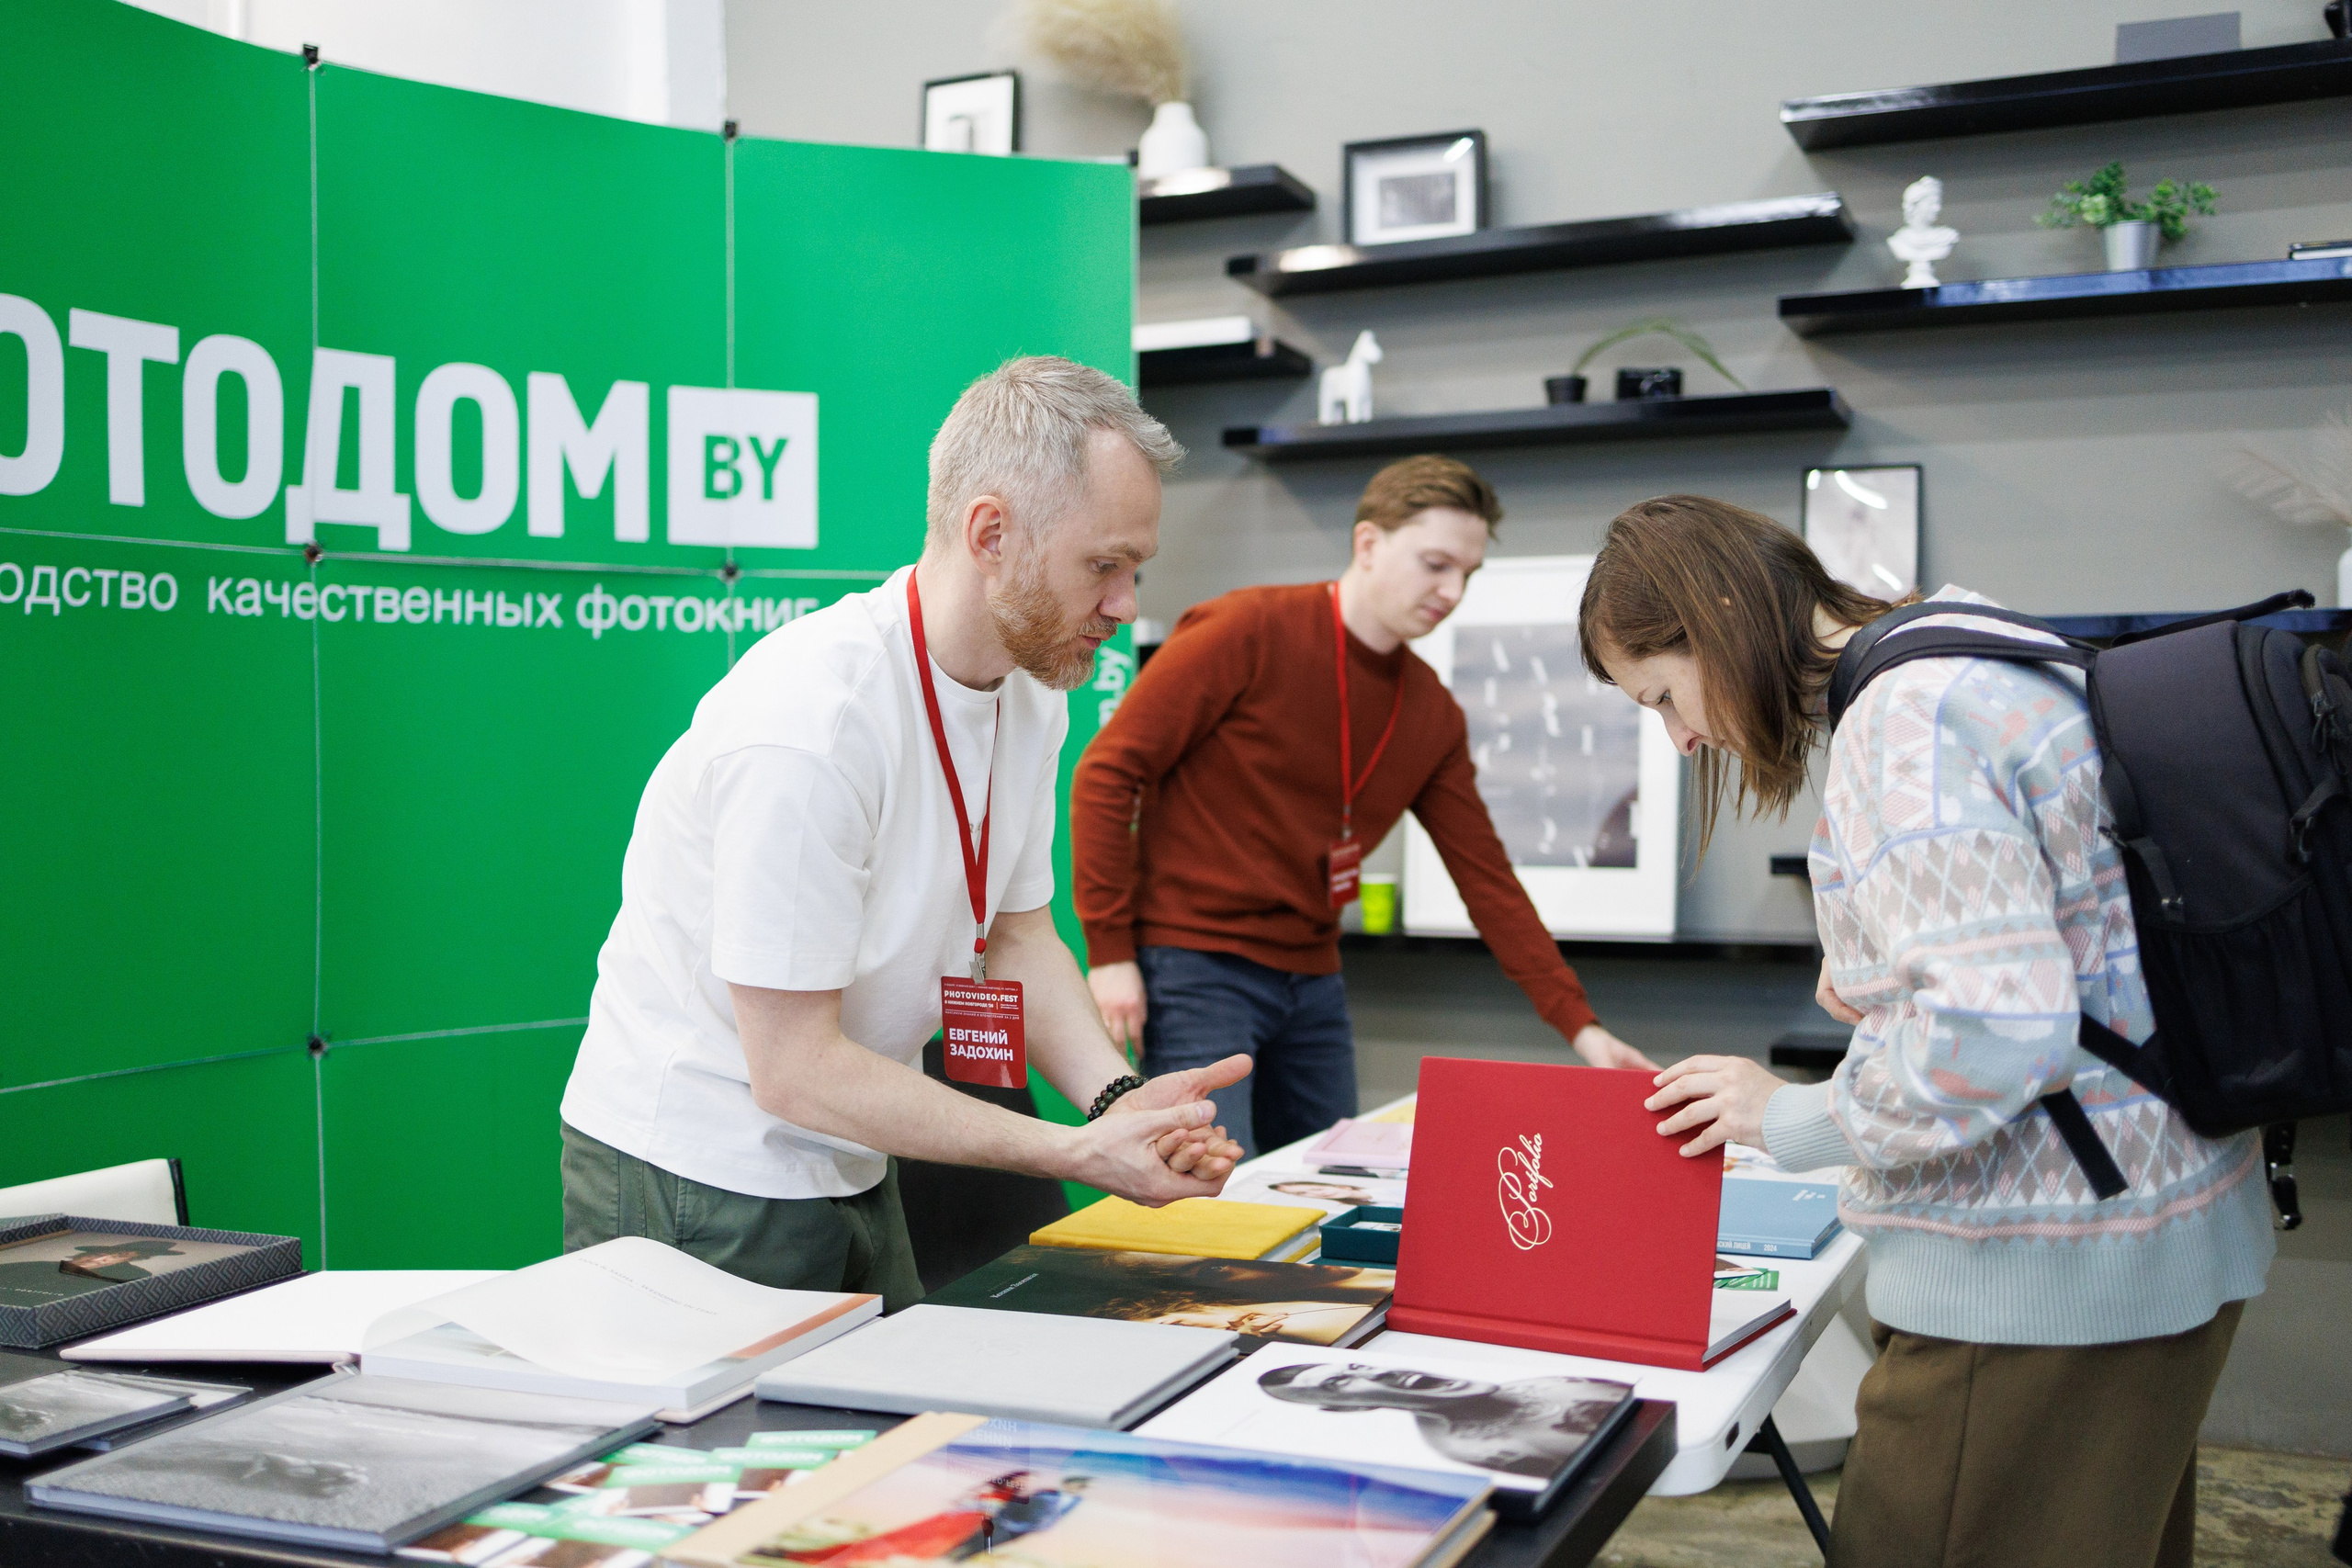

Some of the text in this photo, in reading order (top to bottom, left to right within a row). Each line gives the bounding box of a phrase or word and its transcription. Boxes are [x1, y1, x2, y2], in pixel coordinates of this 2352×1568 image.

[704, 434, 789, 501] BY
[206, 575, 564, 628] качественных
[576, 583, 820, 639] фотокниг
[944, 990, 1019, 1003] PHOTOVIDEO.FEST
[949, 1027, 1009, 1045] ЕВГЕНИЙ
[950, 1043, 1013, 1061] ЗАДОХИН
[1498, 1133, 1554, 1250] Portfolio
